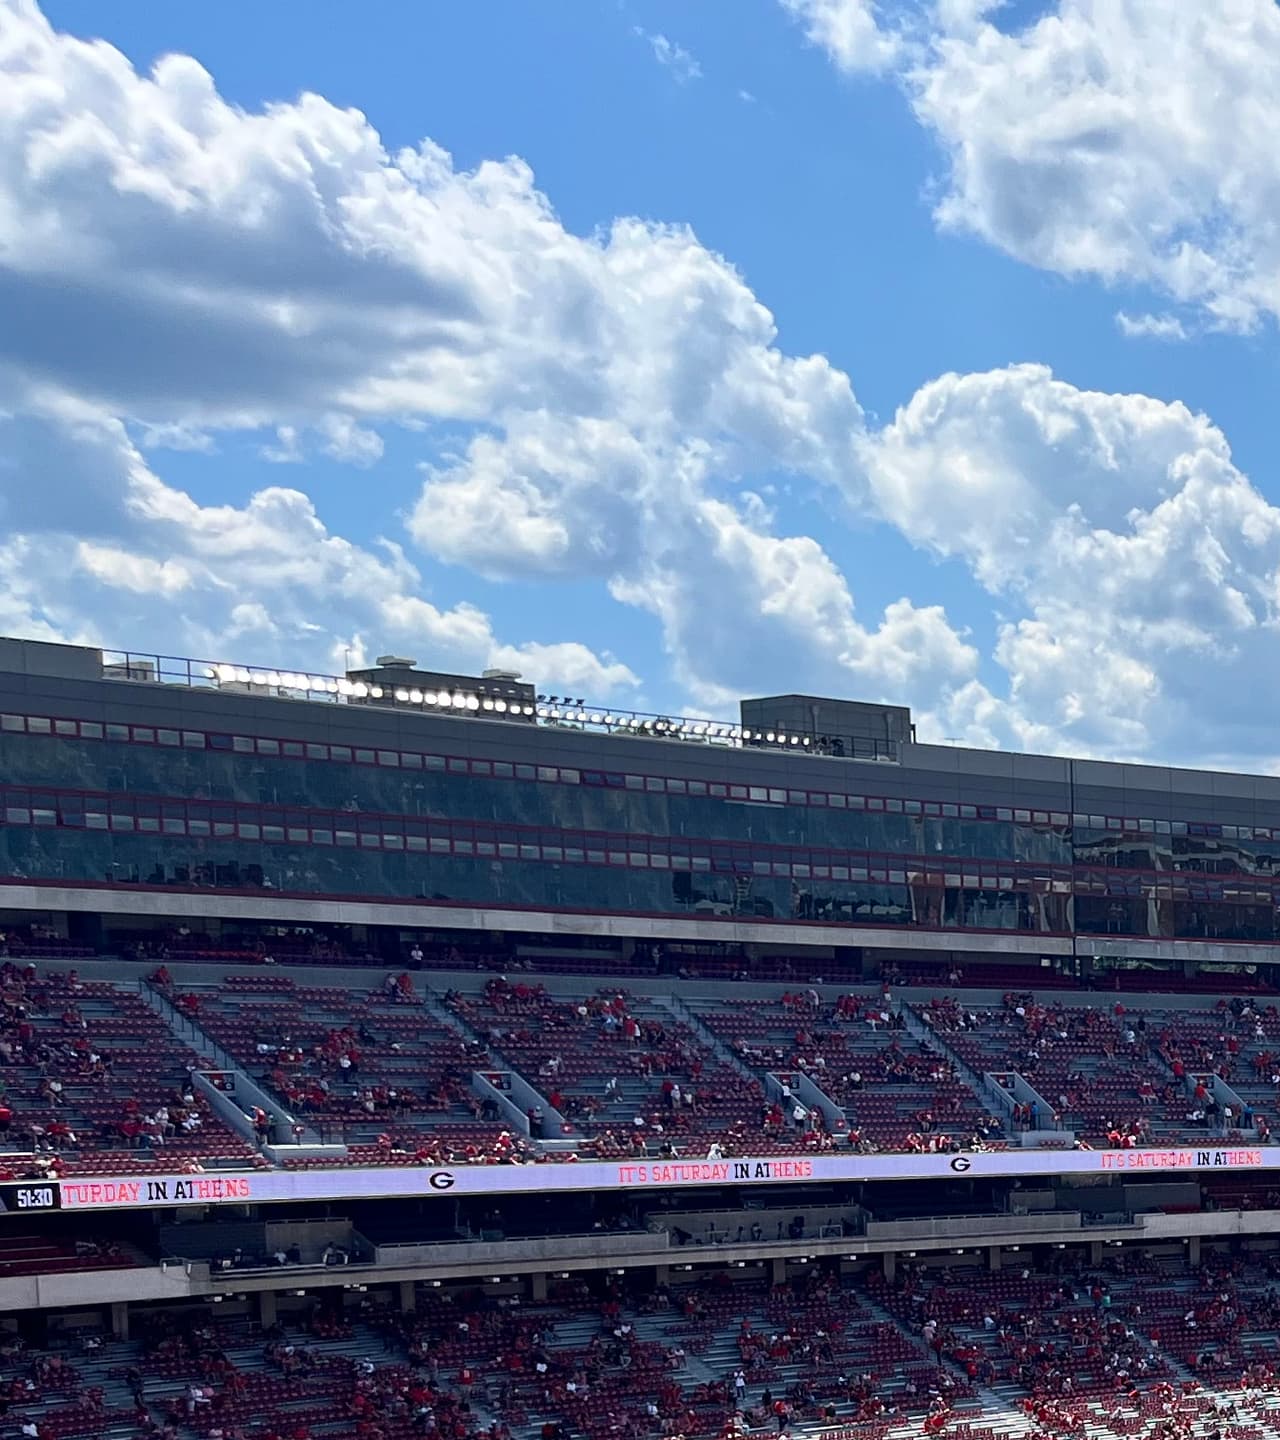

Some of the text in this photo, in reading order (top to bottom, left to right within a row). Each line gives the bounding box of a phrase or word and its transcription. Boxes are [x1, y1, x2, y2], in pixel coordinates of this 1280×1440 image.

[950, 1156, 971, 1172] G
[1101, 1151, 1263, 1168] IT'S SATURDAY IN ATHENS
[429, 1171, 455, 1190] G
[618, 1161, 812, 1183] IT'S SATURDAY IN ATHENS
[17, 1188, 53, 1207] 51:30
[148, 1182, 168, 1200] IN
[174, 1179, 249, 1200] ATHENS
